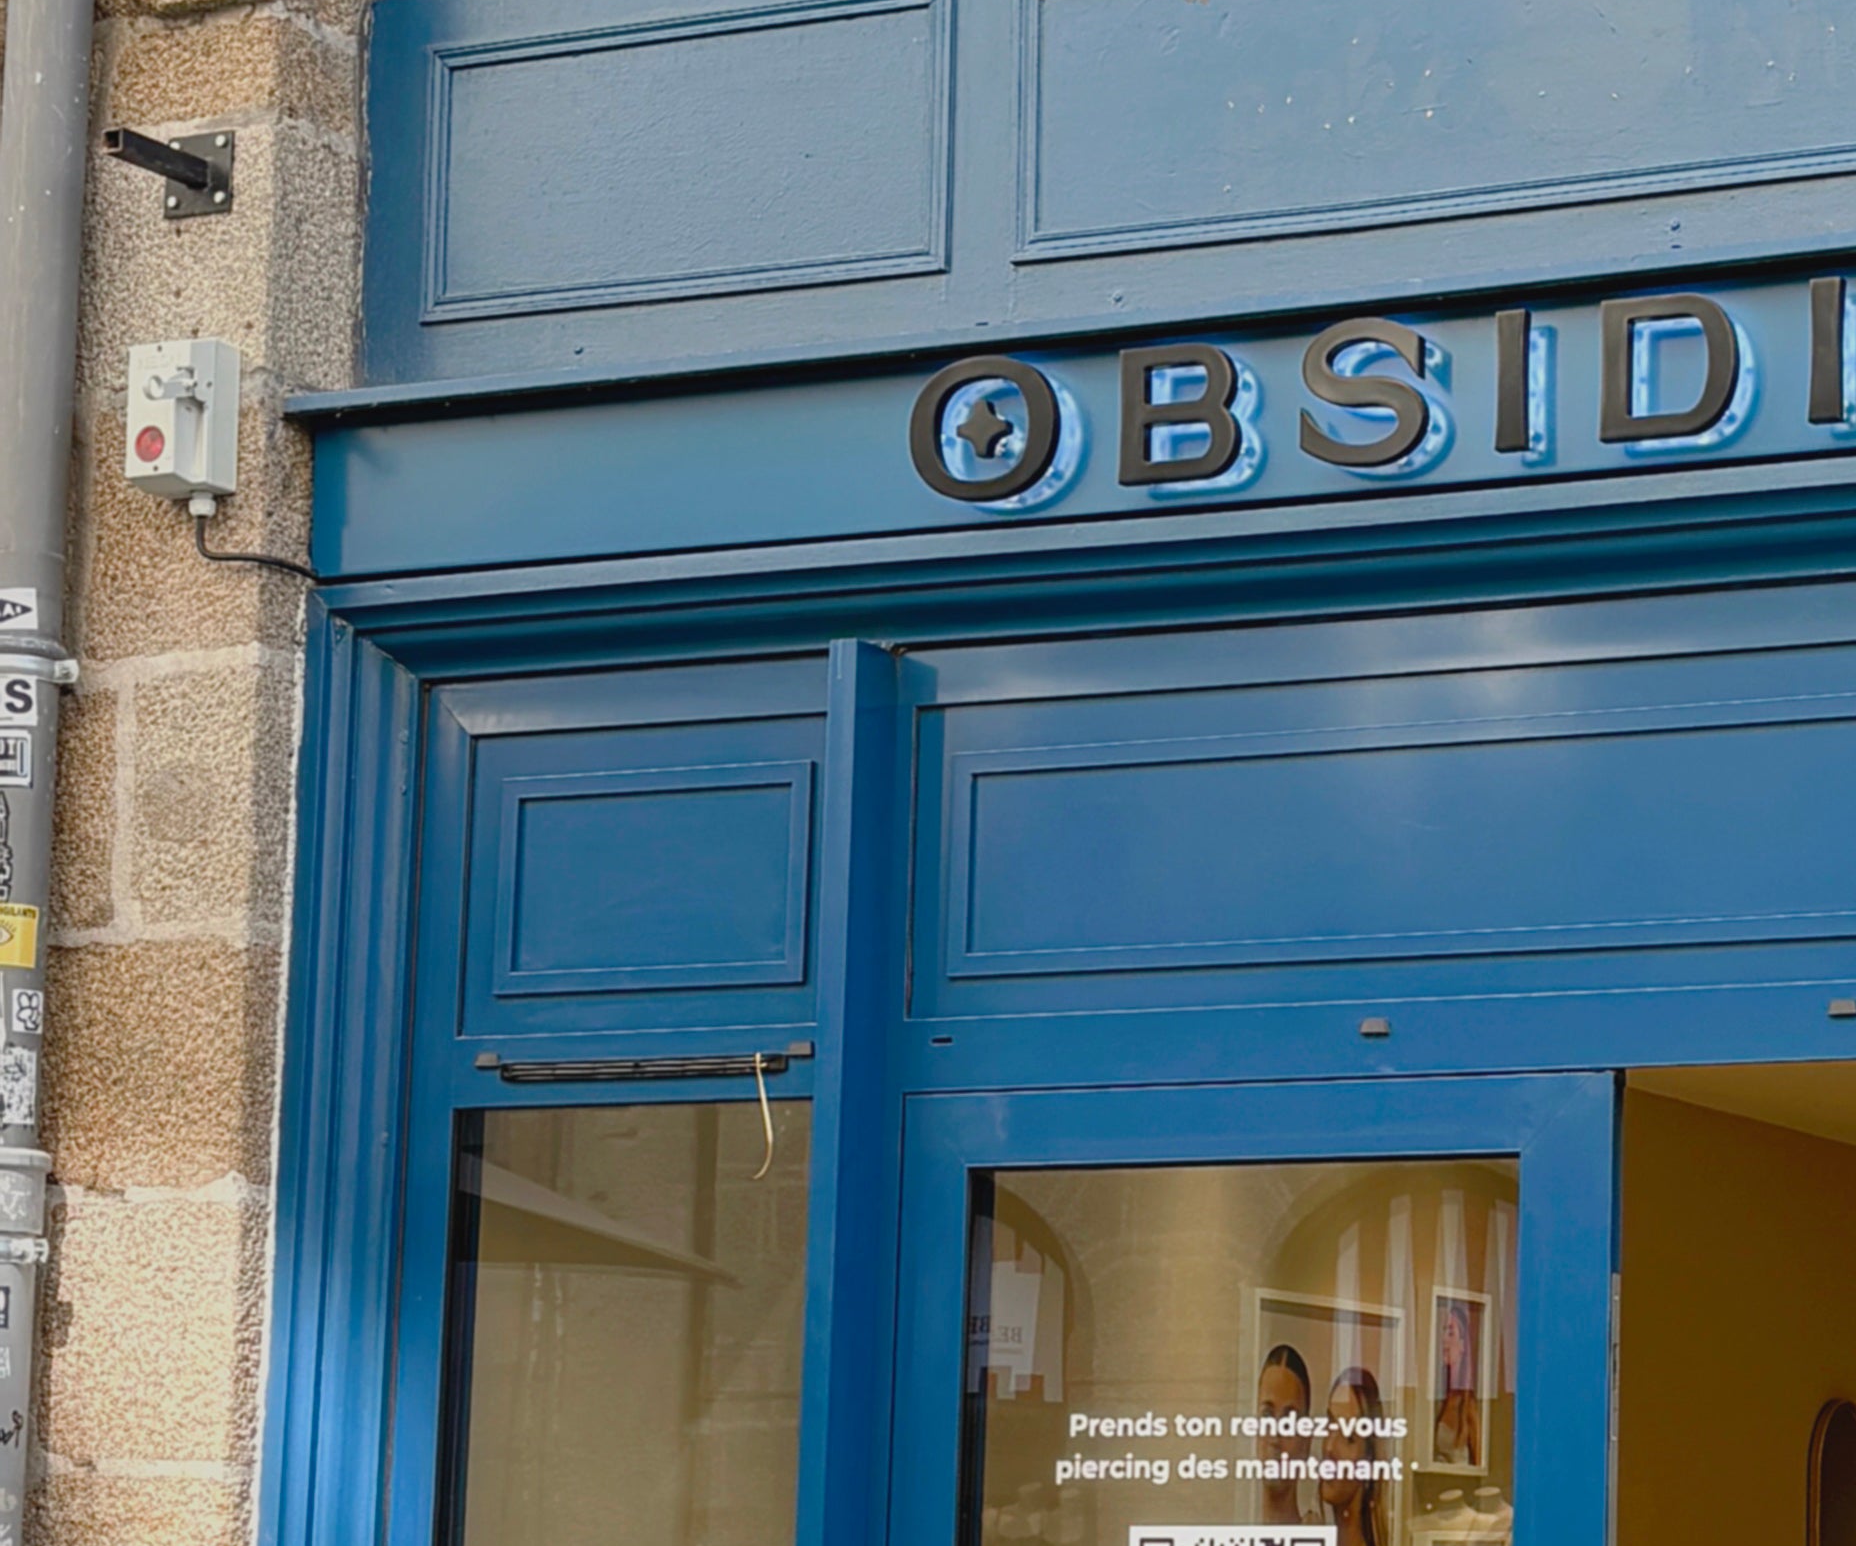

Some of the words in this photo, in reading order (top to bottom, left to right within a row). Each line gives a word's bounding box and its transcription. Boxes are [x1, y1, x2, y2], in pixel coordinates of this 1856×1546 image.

[1069, 1410, 1168, 1438] Prends
[1174, 1412, 1223, 1438] ton
[1229, 1410, 1408, 1439] rendez-vous
[1055, 1451, 1171, 1486] piercing
[1177, 1452, 1229, 1480] des
[1235, 1452, 1404, 1482] maintenant
